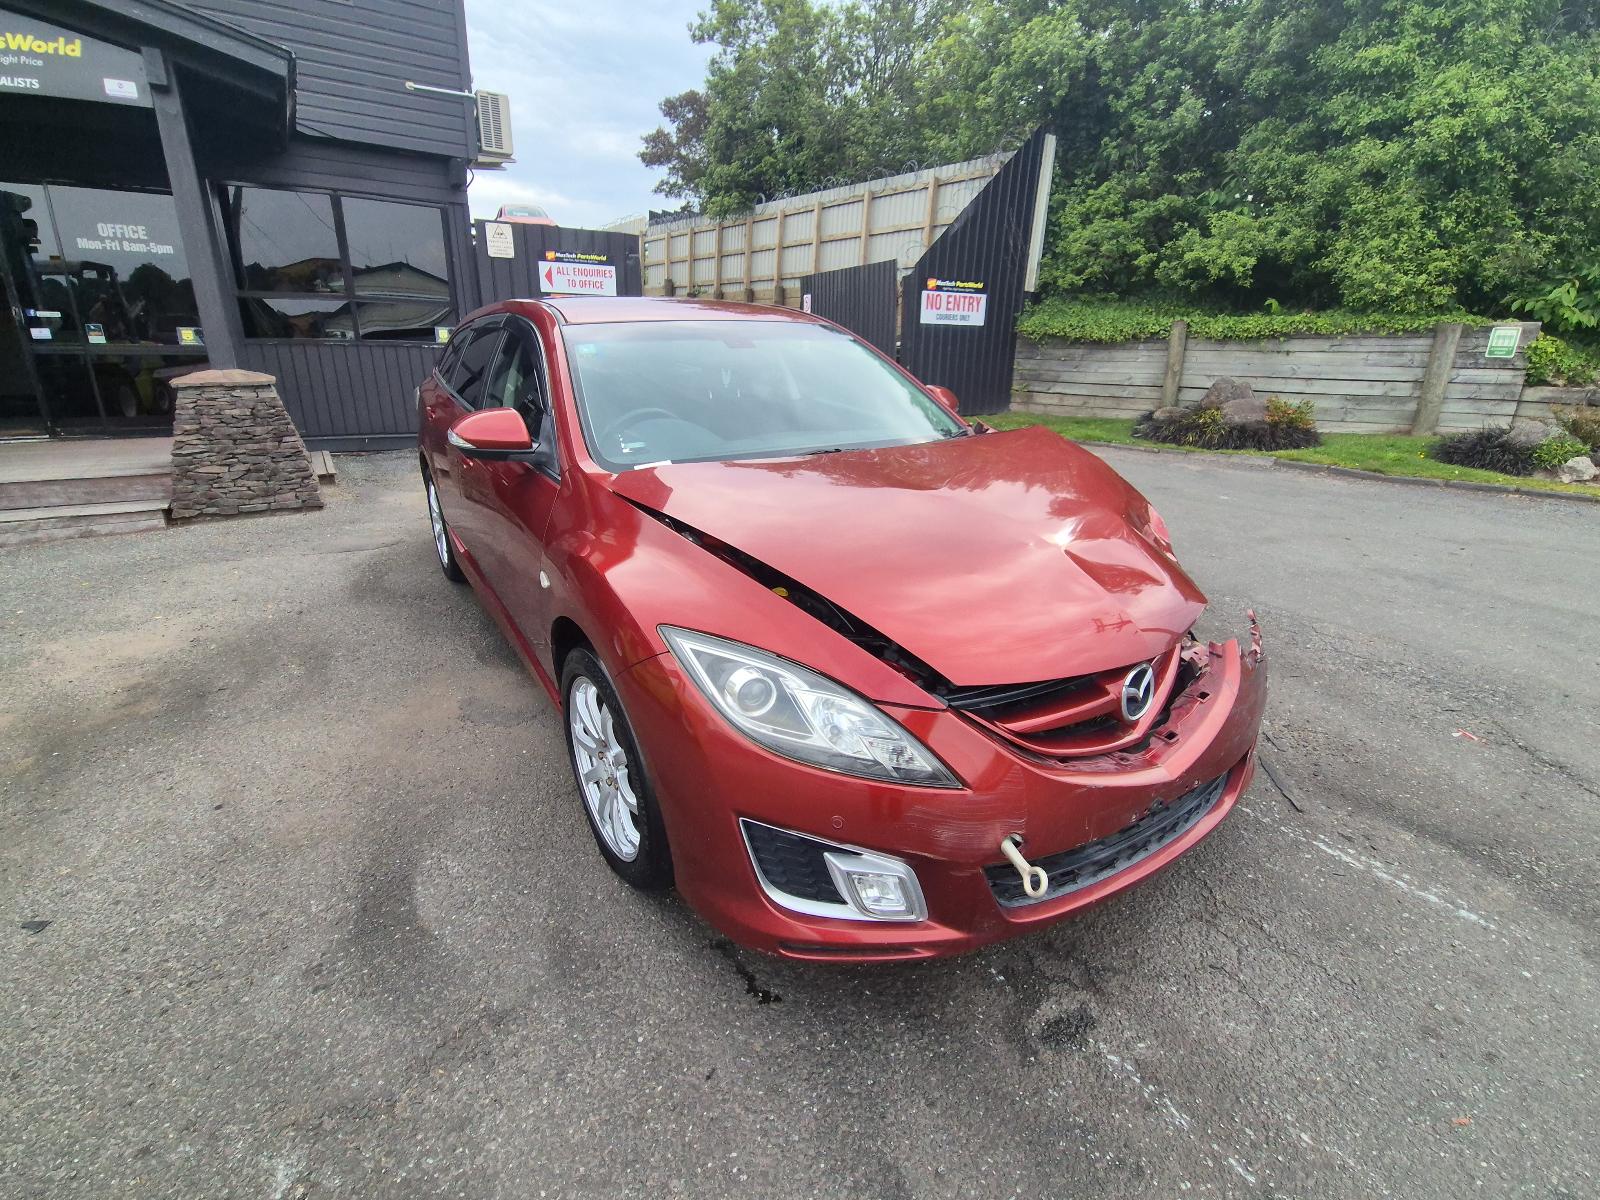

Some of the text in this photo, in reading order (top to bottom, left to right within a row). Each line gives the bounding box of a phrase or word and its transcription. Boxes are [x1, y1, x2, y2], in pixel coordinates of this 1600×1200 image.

[20, 55, 43, 66] Price
[96, 222, 148, 240] OFFICE
[76, 237, 121, 251] Mon-Fri
[556, 266, 613, 279] ALL ENQUIRIES
[567, 278, 604, 290] TO OFFICE
[926, 293, 982, 313] NO ENTRY
